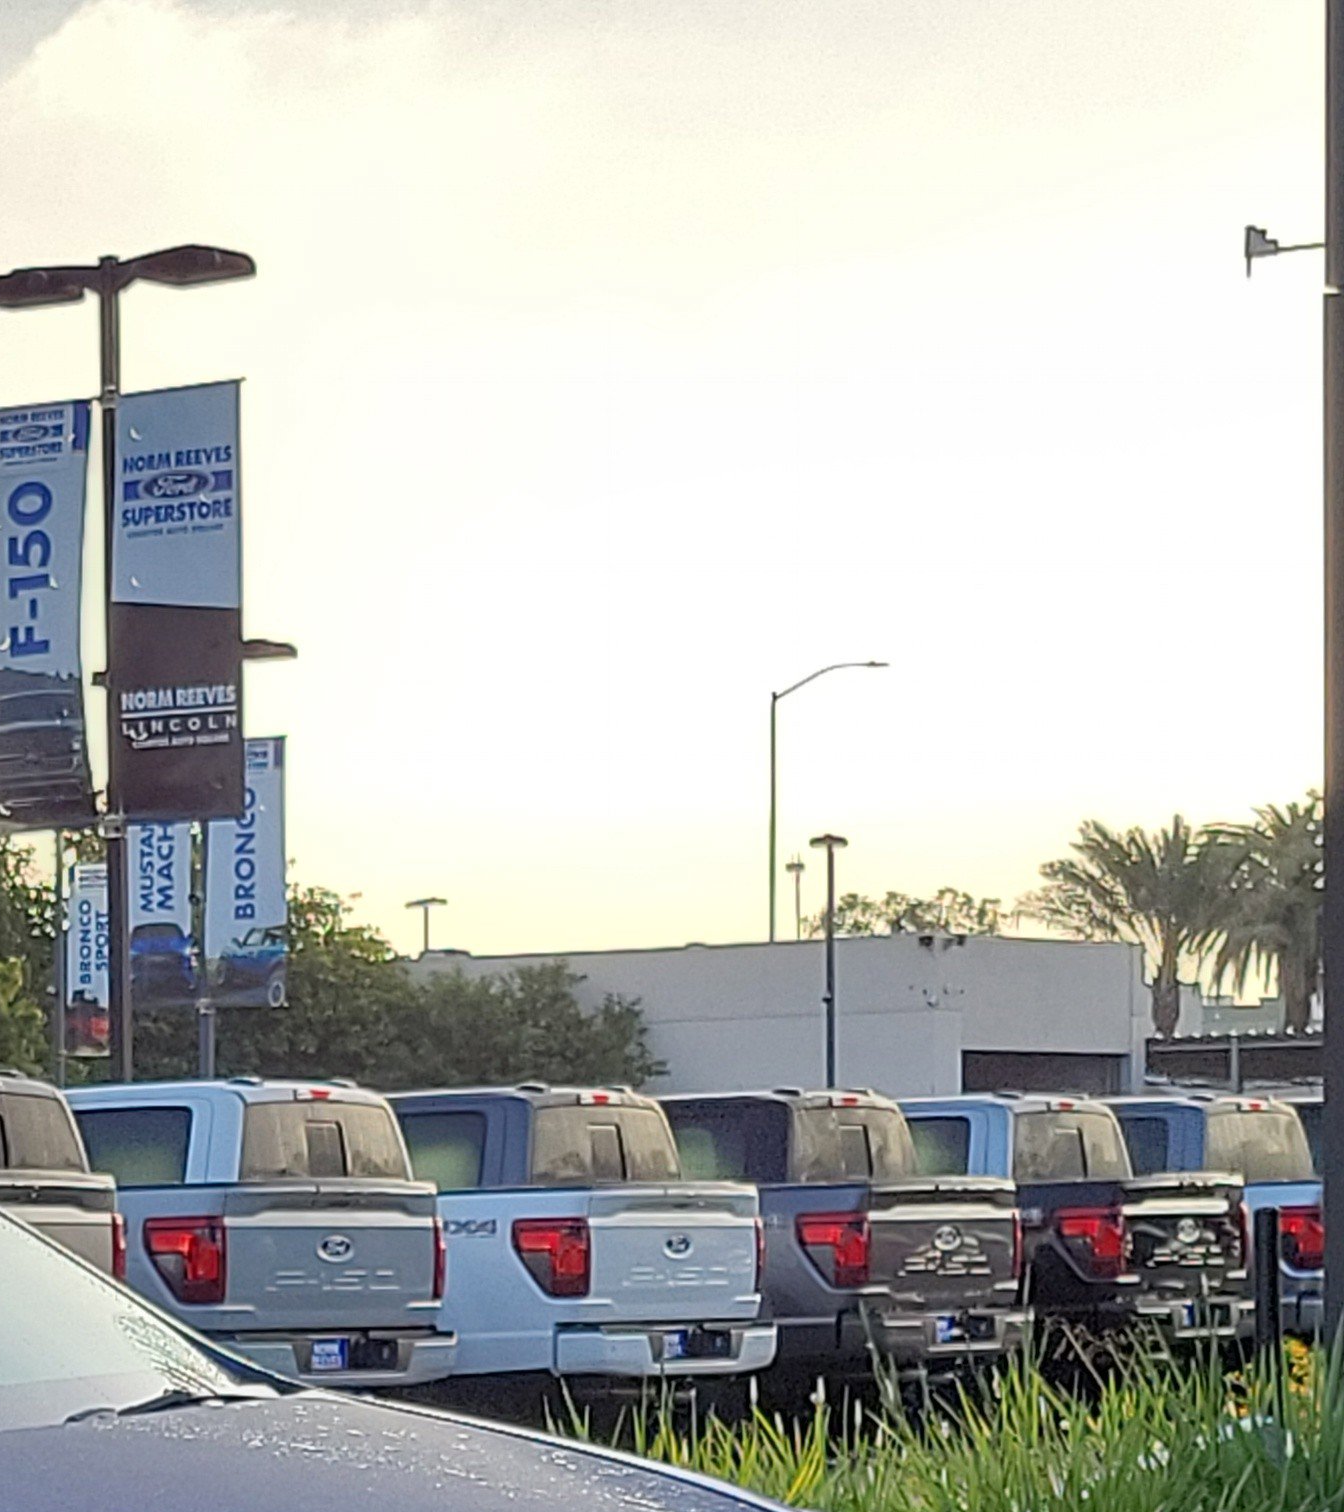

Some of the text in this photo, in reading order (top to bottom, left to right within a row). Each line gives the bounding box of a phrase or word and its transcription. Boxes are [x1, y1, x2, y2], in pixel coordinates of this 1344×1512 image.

[122, 445, 233, 473] NORM REEVES
[121, 498, 233, 528] SUPERSTORE
[7, 480, 54, 659] F-150
[120, 684, 237, 711] NORM REEVES
[121, 714, 237, 736] LINCOLN
[77, 899, 92, 985] BRONCO
[95, 911, 109, 972] SPORT
